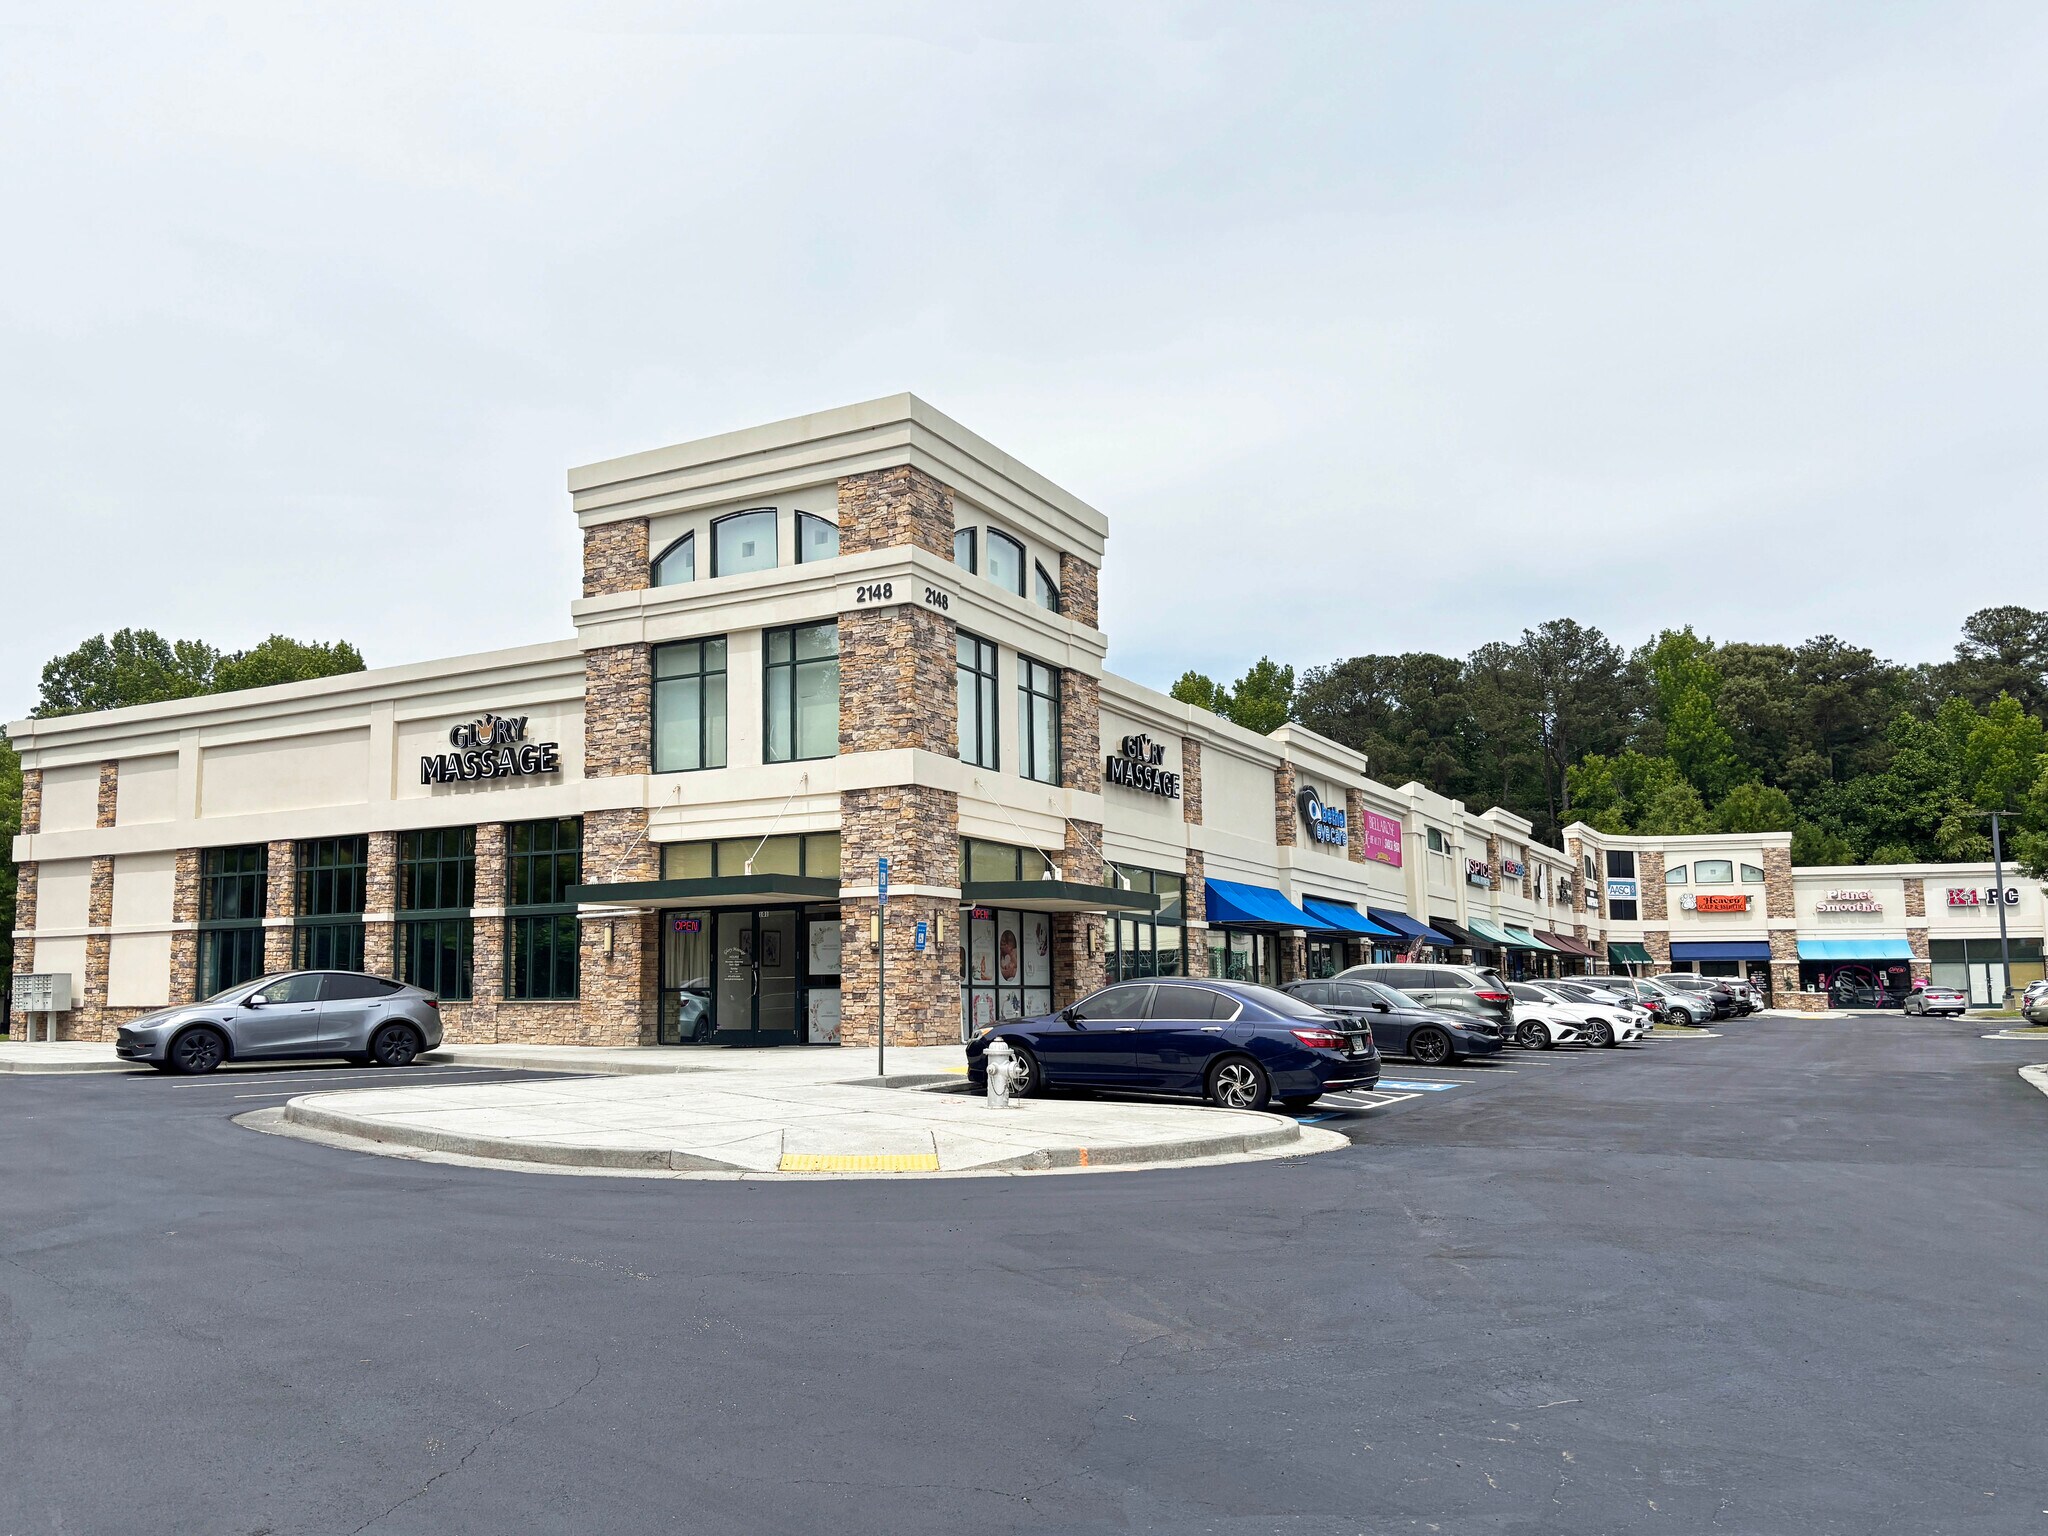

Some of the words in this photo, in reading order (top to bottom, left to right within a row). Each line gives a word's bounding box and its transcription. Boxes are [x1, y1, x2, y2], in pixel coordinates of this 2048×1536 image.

[856, 582, 893, 603] 2148
[925, 586, 949, 611] 2148
[450, 713, 528, 748] GLORY
[1122, 733, 1166, 766] GLORY
[420, 742, 559, 785] MASSAGE
[1106, 755, 1180, 799] MASSAGE
[1469, 859, 1493, 879] SPICE
[1610, 885, 1630, 895] AASC
[1825, 889, 1874, 901] Planet
[1946, 887, 1980, 906] K1
[972, 909, 989, 920] OPEN
[1816, 901, 1884, 913] Smoothie
[674, 920, 699, 931] OPEN
